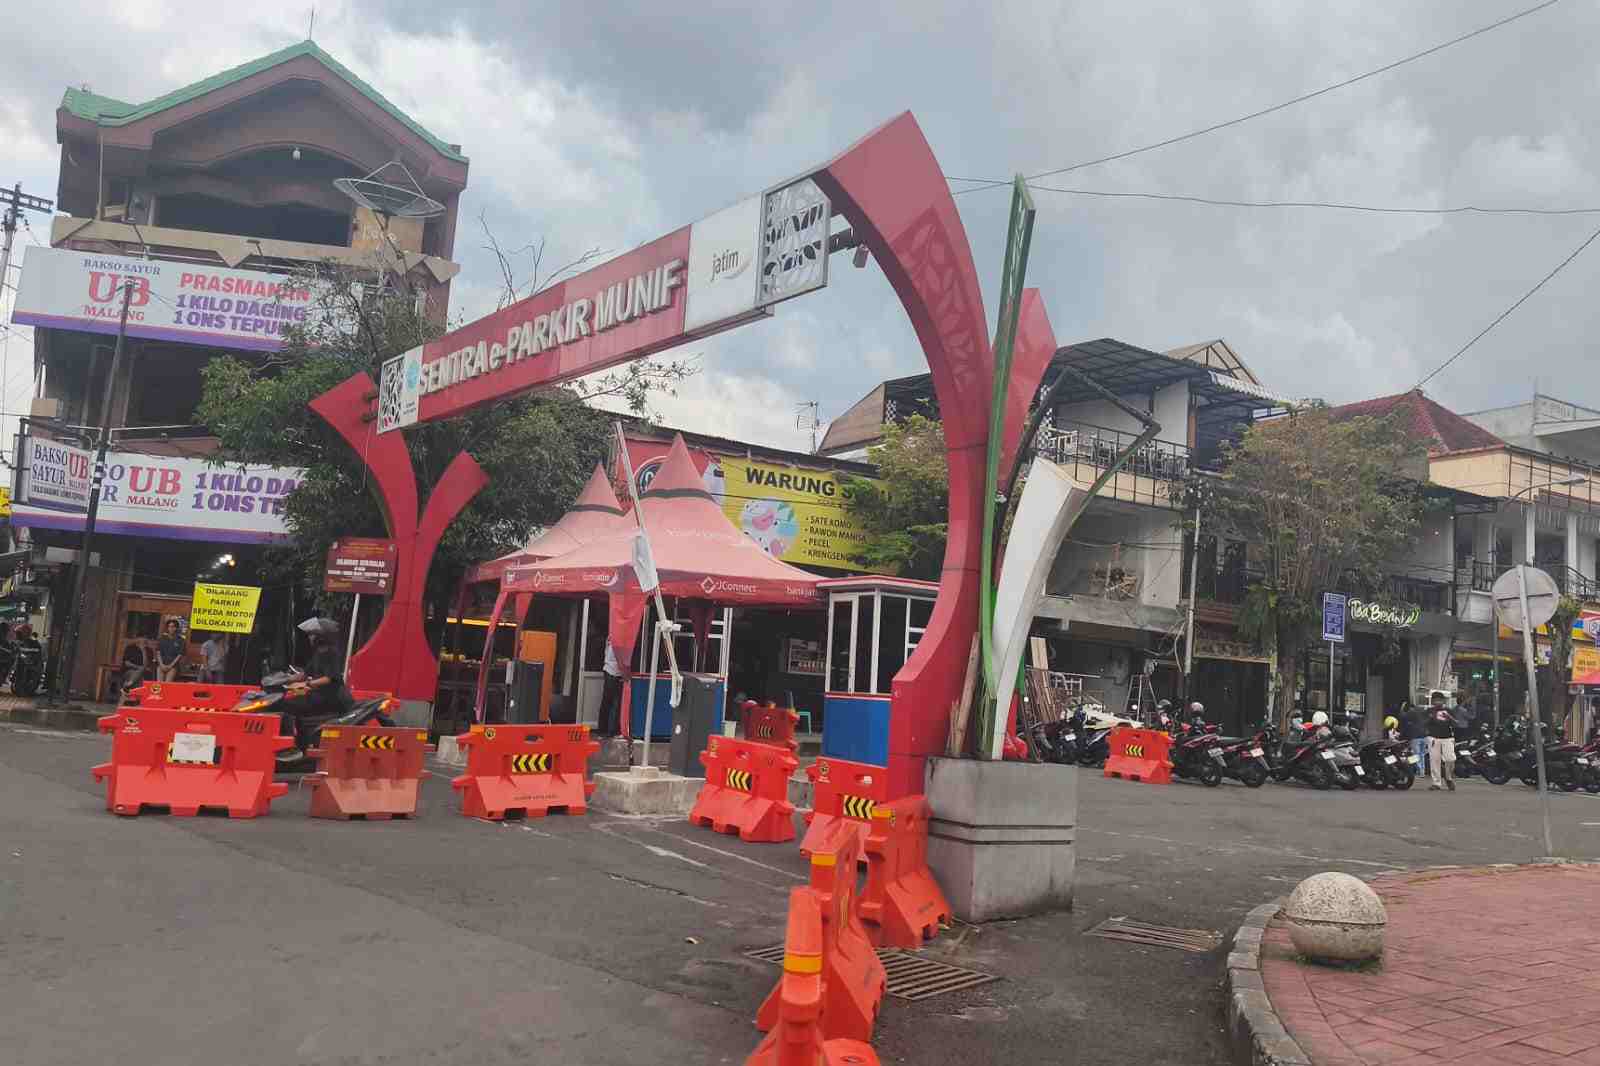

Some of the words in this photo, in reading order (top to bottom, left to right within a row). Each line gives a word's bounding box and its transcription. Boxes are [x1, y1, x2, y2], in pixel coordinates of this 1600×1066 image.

[83, 258, 119, 272] BAKSO
[121, 260, 161, 275] SAYUR
[710, 249, 739, 283] jatim
[88, 271, 150, 307] UB
[188, 294, 233, 313] KILO
[234, 299, 305, 321] DAGING
[186, 312, 226, 329] ONS
[417, 341, 488, 395] SENTRA
[593, 258, 685, 332] MUNIF
[34, 444, 68, 466] BAKSO
[69, 453, 89, 479] UB
[32, 464, 66, 485] SAYUR
[128, 465, 182, 495] UB
[210, 473, 263, 493] KILO
[745, 466, 835, 496] WARUNG
[127, 494, 179, 508] MALANG
[207, 494, 256, 512] ONS
[209, 598, 241, 607] PARKIR
